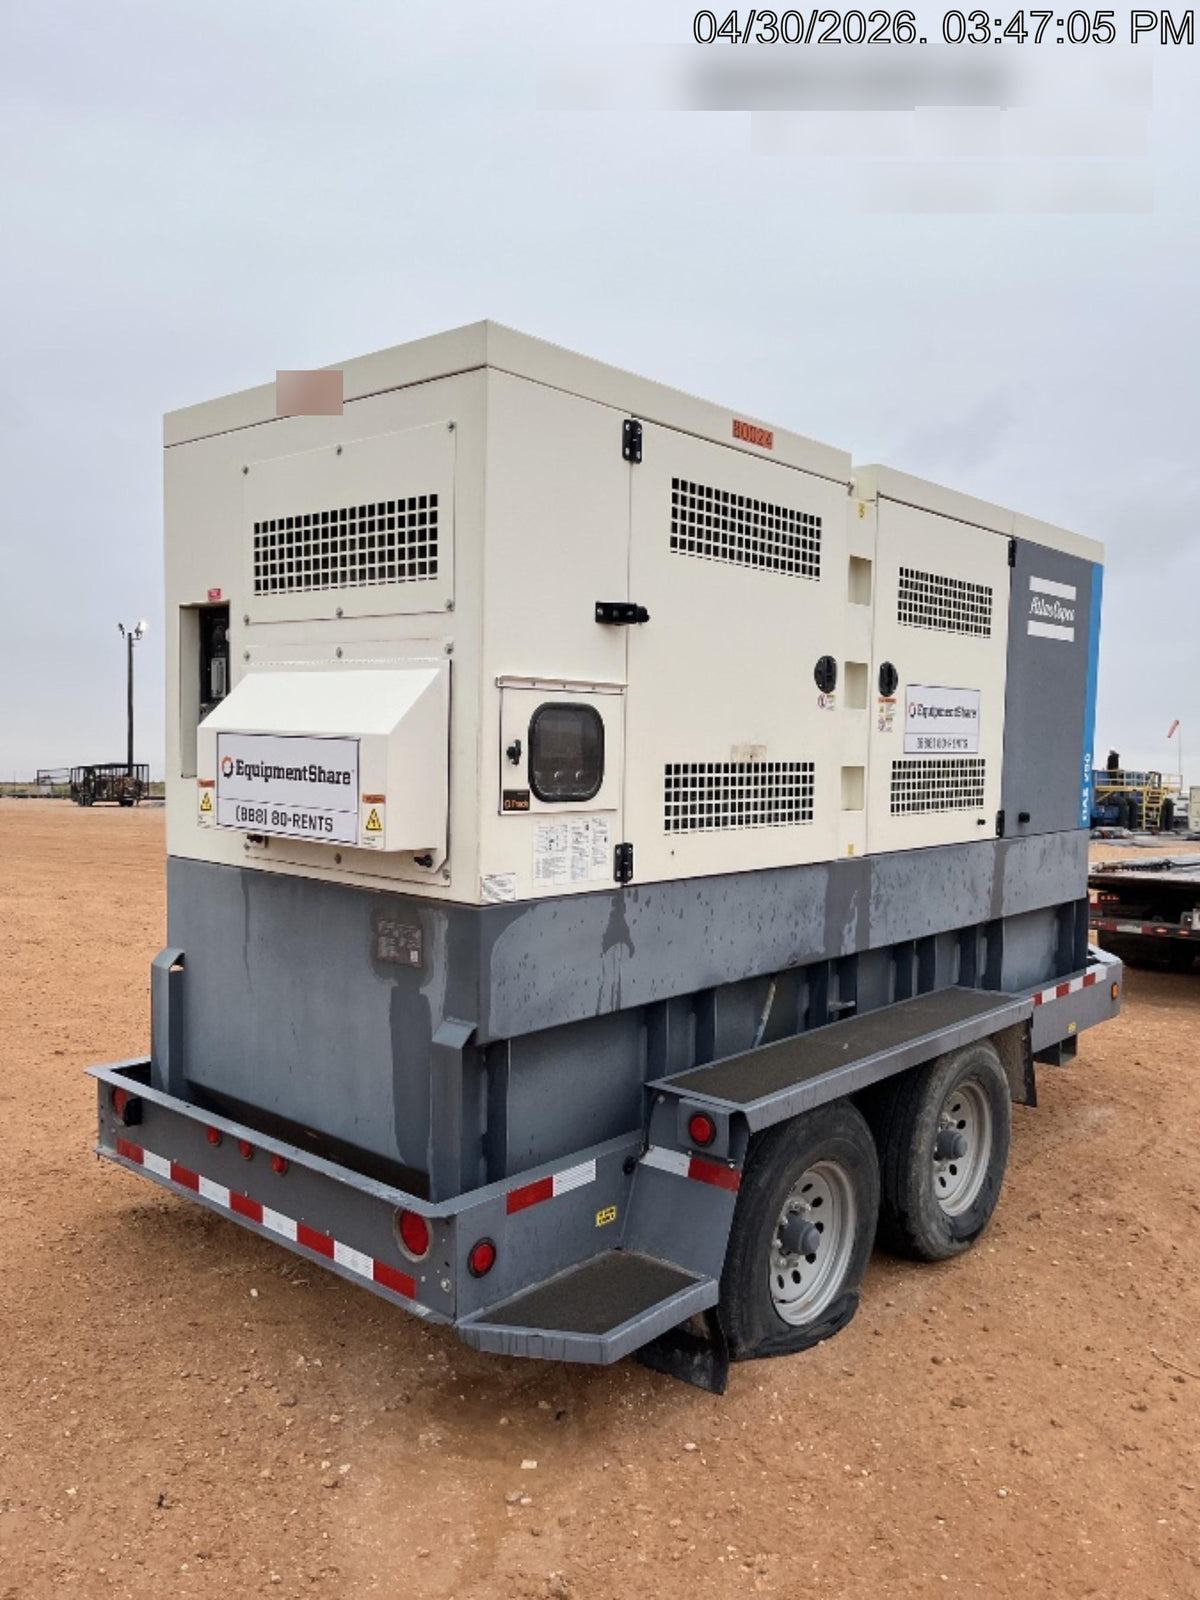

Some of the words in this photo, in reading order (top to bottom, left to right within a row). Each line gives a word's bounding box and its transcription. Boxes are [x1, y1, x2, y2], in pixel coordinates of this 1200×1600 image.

[235, 758, 352, 785] EquipmentShare
[235, 804, 268, 826] (888)
[271, 808, 334, 833] 80-RENTS
